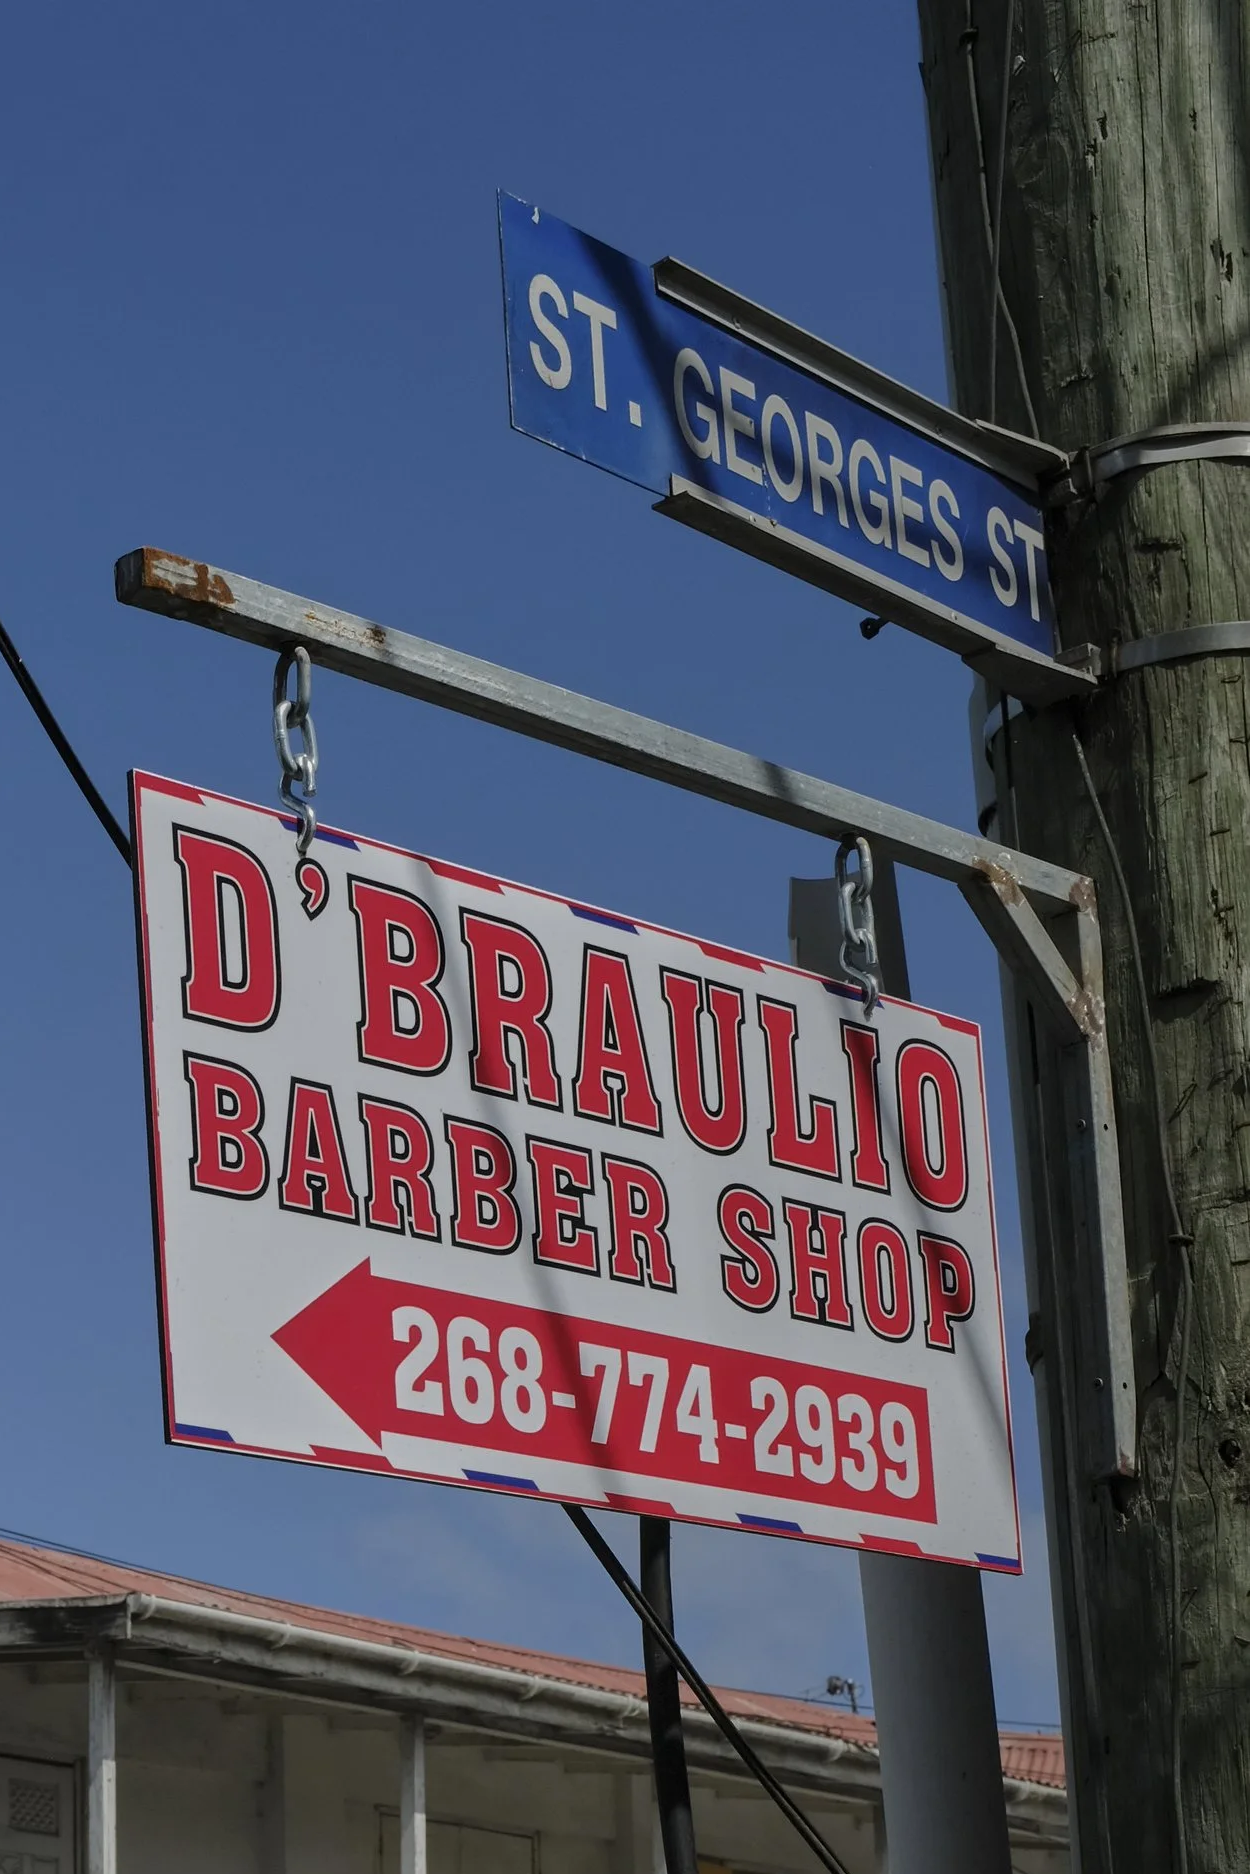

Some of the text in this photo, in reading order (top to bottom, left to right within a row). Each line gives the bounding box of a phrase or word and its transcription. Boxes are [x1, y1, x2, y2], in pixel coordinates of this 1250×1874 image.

[528, 273, 1045, 622] ST. GEORGES ST
[172, 822, 969, 1213] D'BRAULIO
[182, 1051, 977, 1353] BARBER SHOP
[392, 1306, 921, 1500] 268-774-2939
